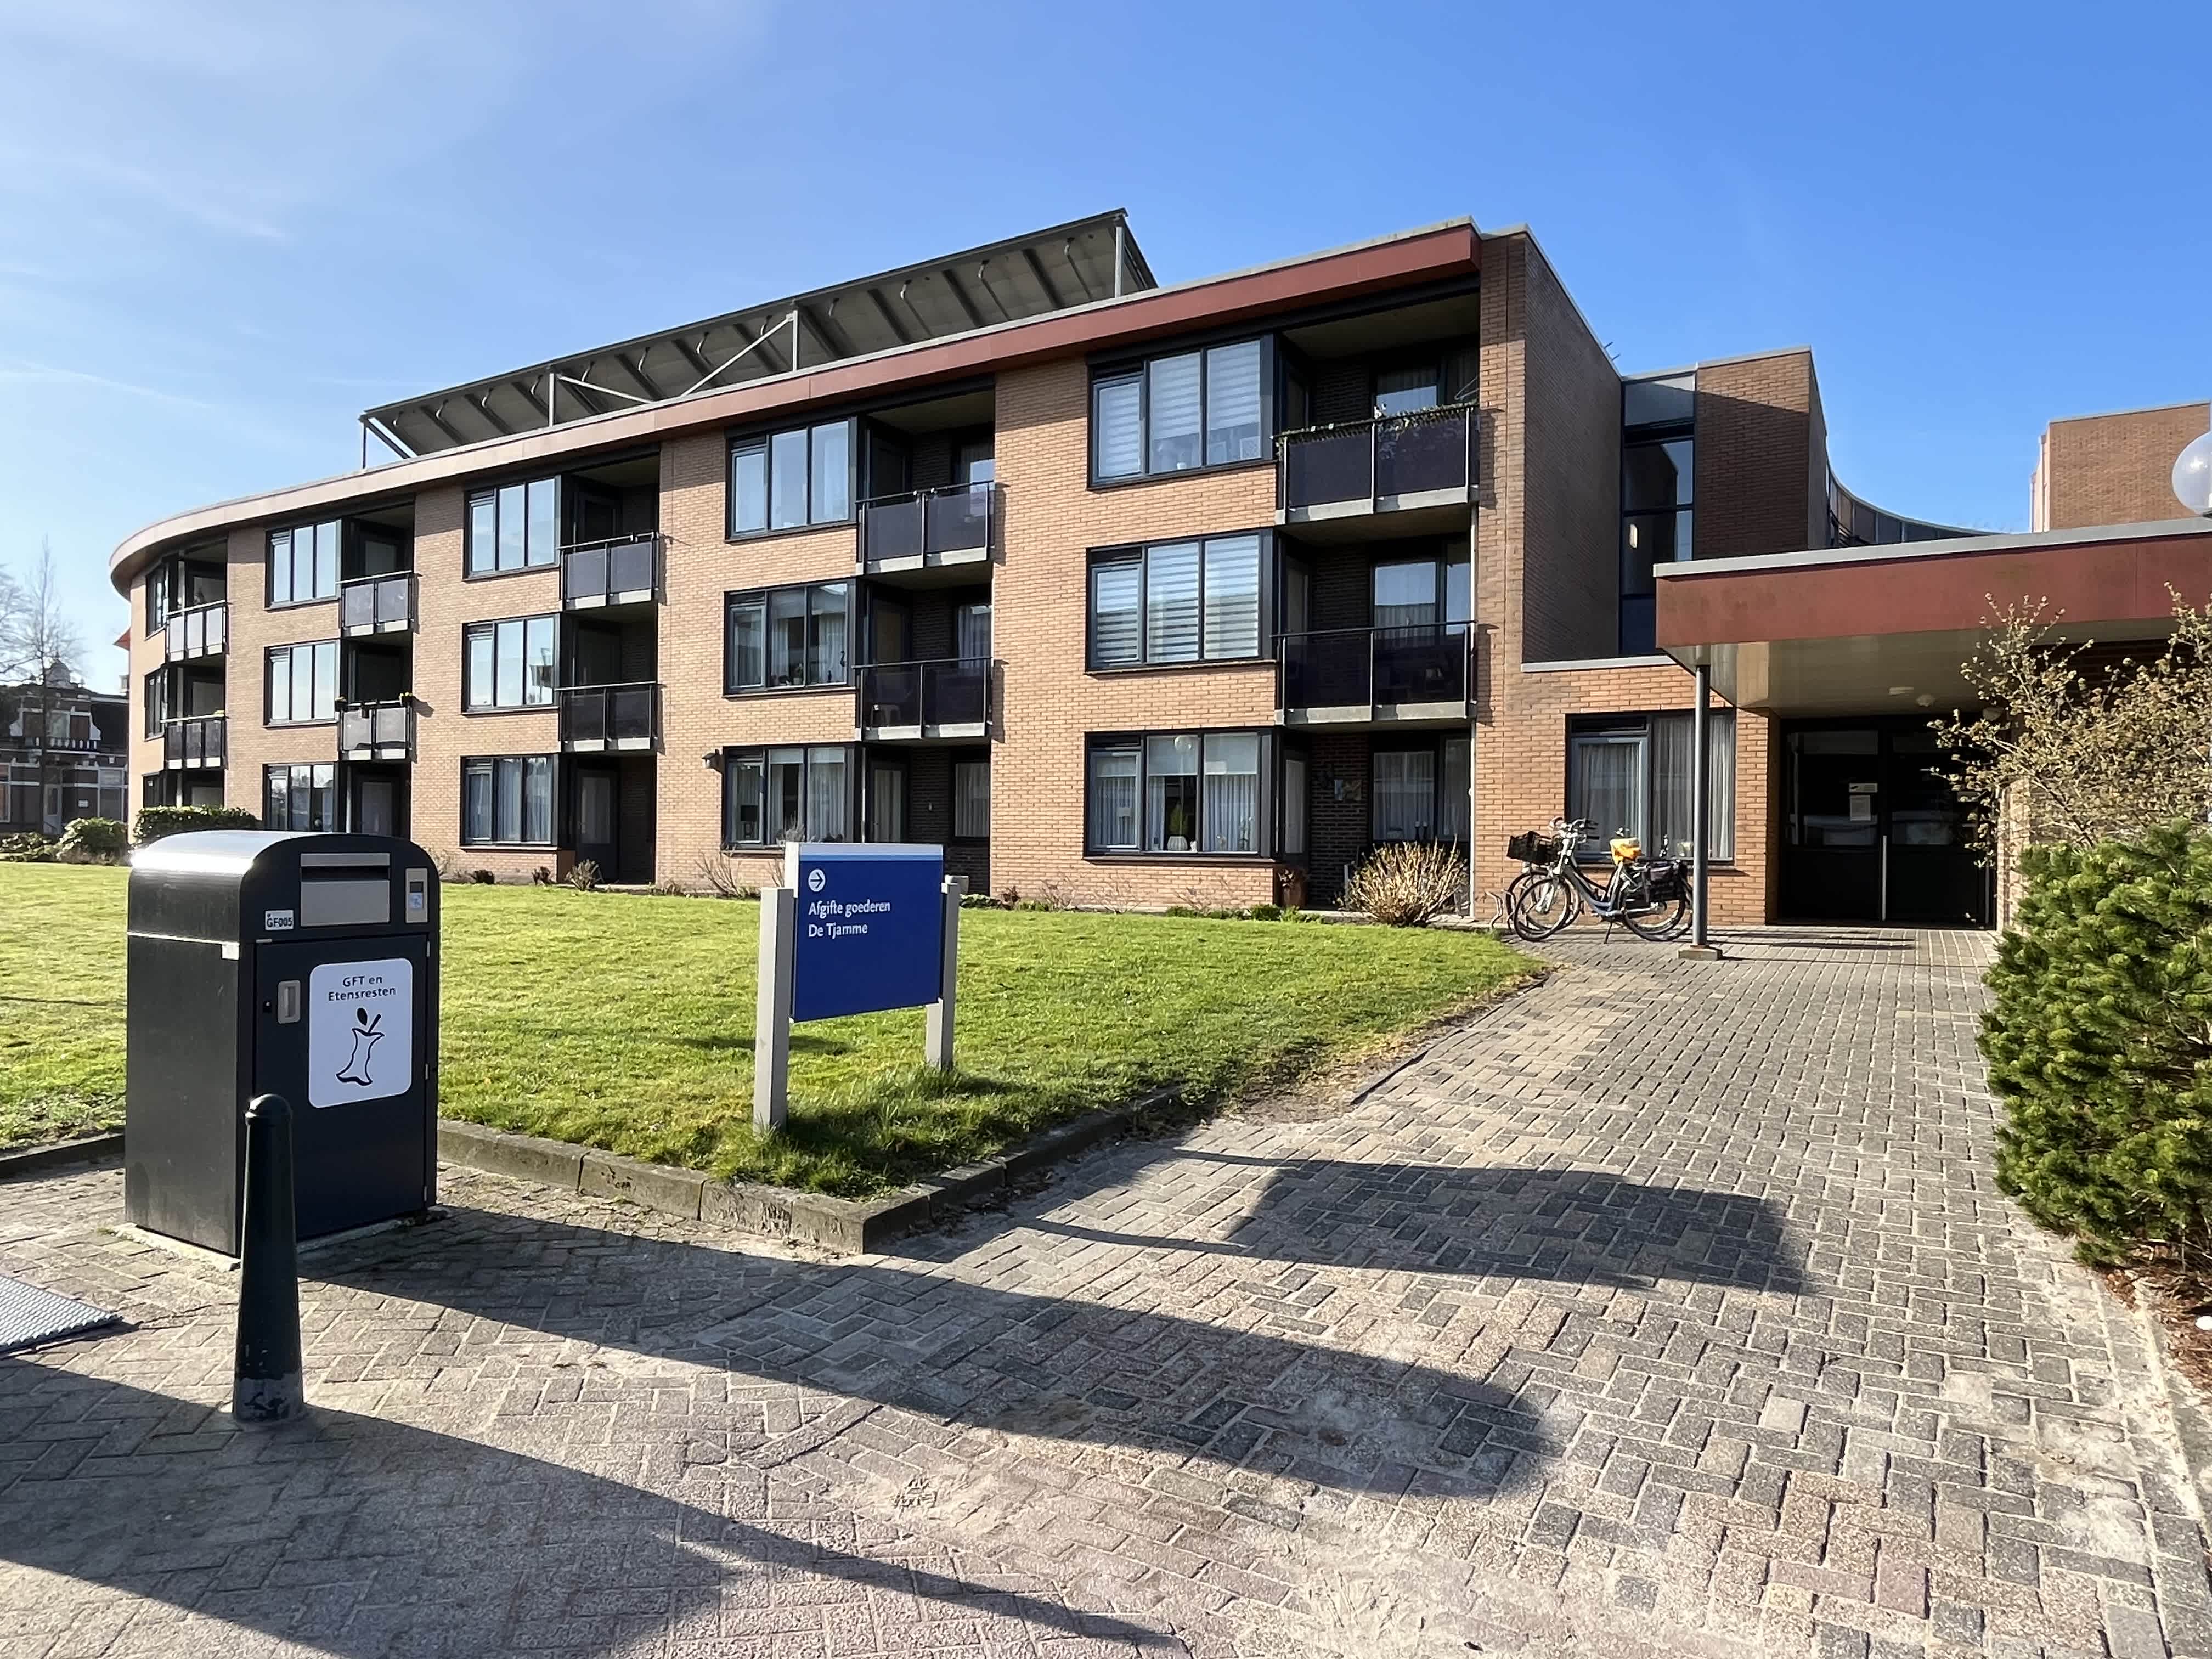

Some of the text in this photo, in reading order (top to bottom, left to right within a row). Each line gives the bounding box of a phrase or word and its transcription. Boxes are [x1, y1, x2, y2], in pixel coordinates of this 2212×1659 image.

[808, 899, 891, 919] Afgifte goederen
[808, 922, 868, 939] De Tjamme
[342, 975, 382, 987] GFT en
[328, 987, 396, 1001] Etensresten
